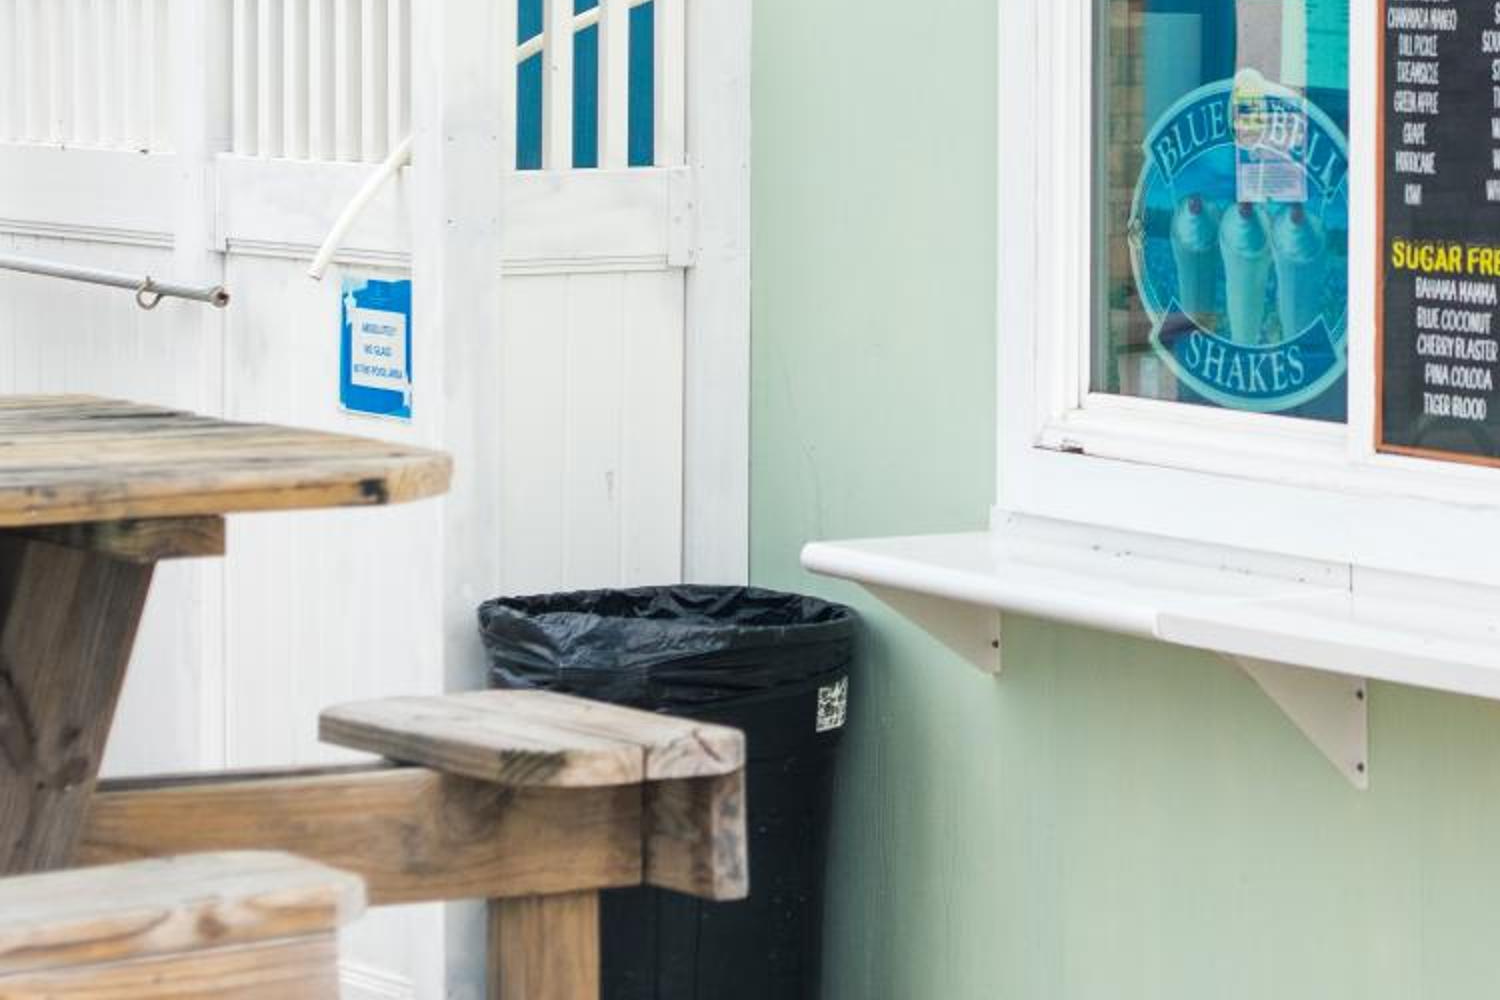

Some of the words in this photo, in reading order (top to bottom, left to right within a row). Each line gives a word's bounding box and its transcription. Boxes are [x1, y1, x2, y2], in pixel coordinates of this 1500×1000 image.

[1157, 101, 1227, 173] BLUE
[1392, 240, 1462, 274] SUGAR
[1415, 276, 1457, 304] BAHAMA
[1416, 305, 1440, 330] BLUE
[1441, 309, 1493, 334] COCONUT
[1184, 329, 1305, 393] SHAKES
[1416, 335, 1454, 359] CHERRY
[1455, 339, 1499, 363] BLASTER
[1425, 363, 1449, 386] PINA
[1424, 391, 1451, 417] TIGER
[1452, 394, 1487, 421] BLOOD
